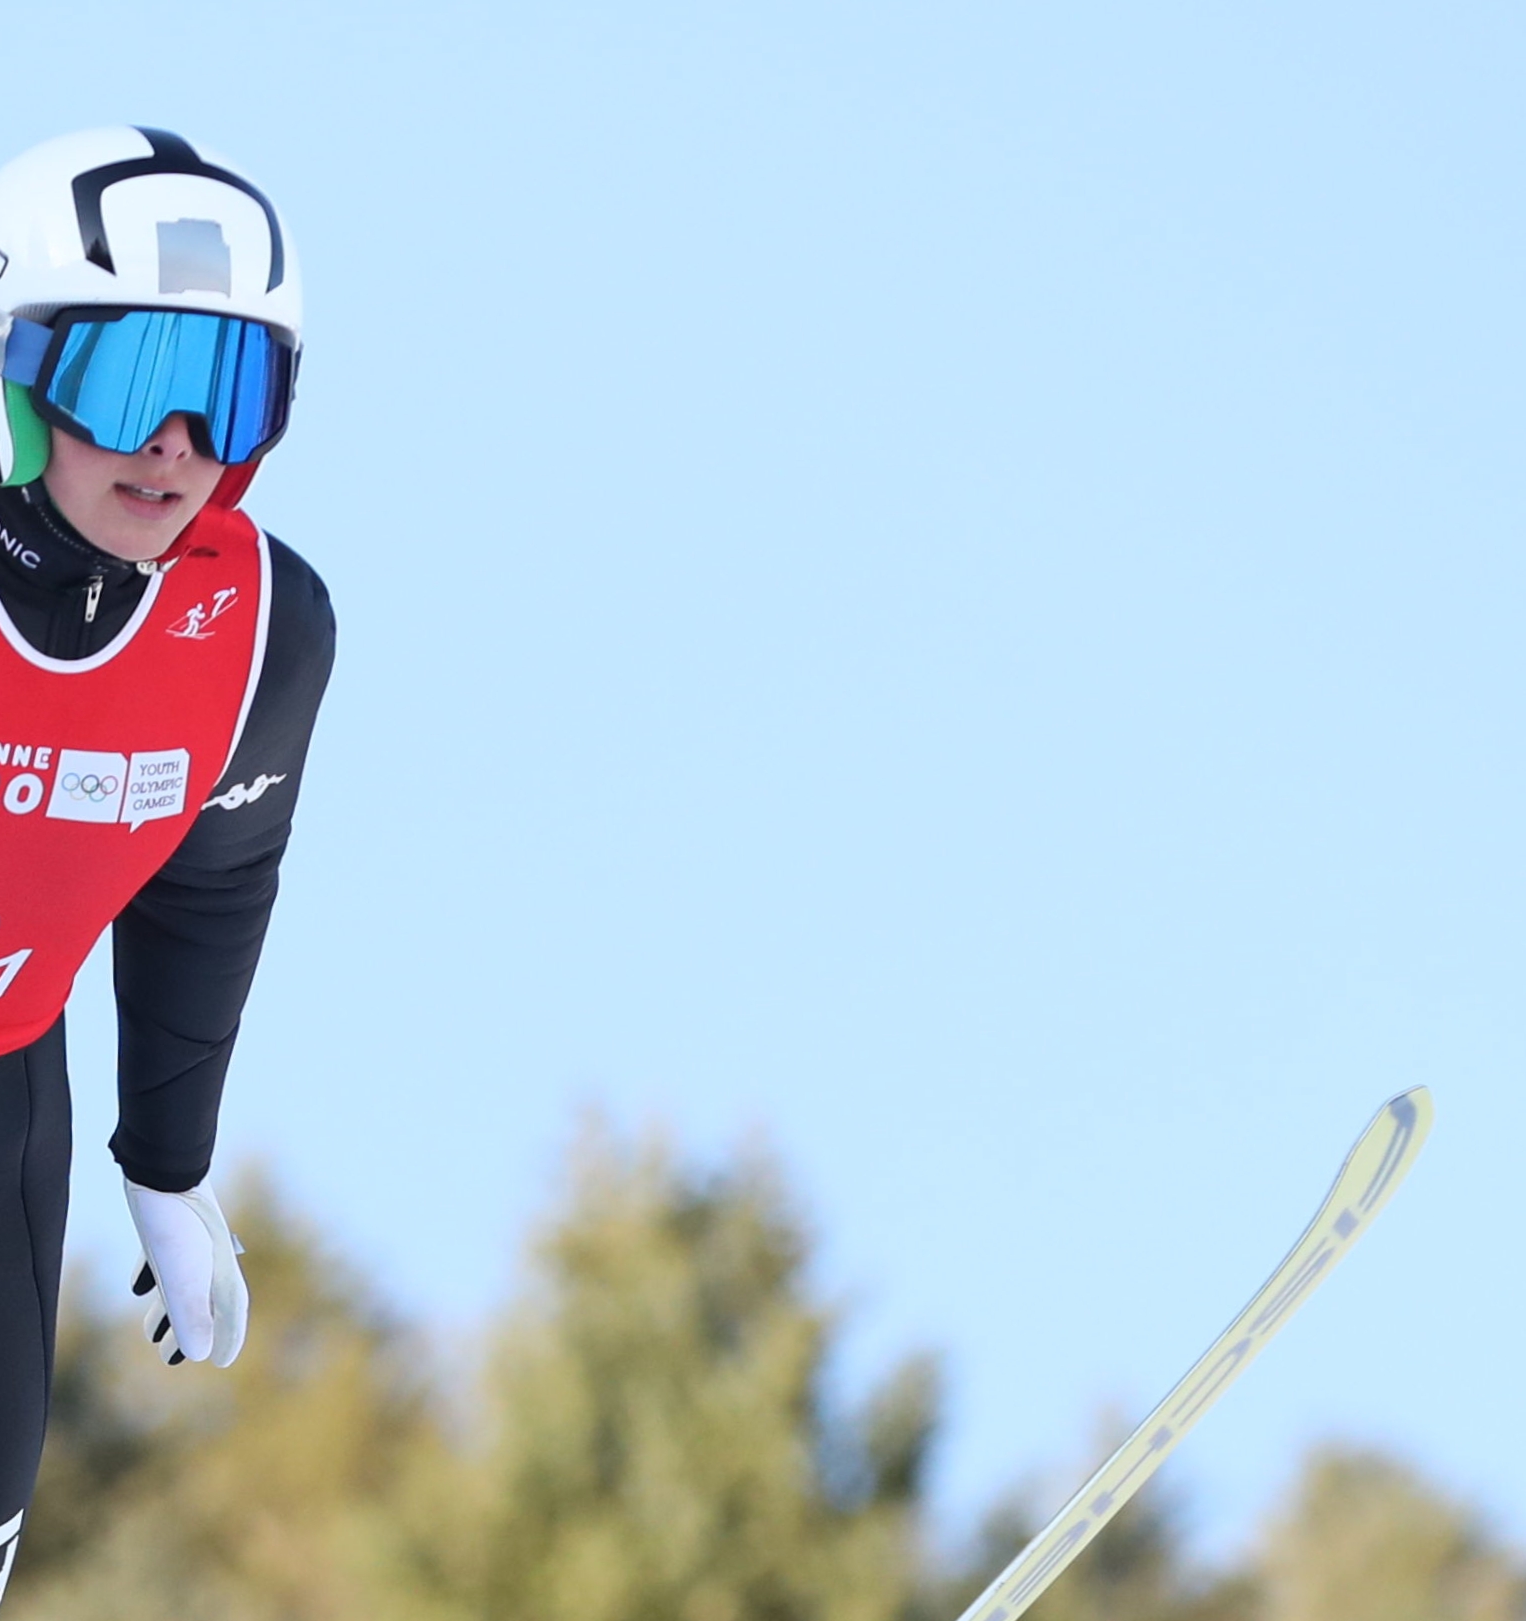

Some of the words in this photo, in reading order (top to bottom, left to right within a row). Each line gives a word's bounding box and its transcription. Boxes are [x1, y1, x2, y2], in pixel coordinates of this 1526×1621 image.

[139, 760, 180, 777] YOUTH
[130, 776, 183, 795] OLYMPIC
[133, 794, 176, 811] GAMES
